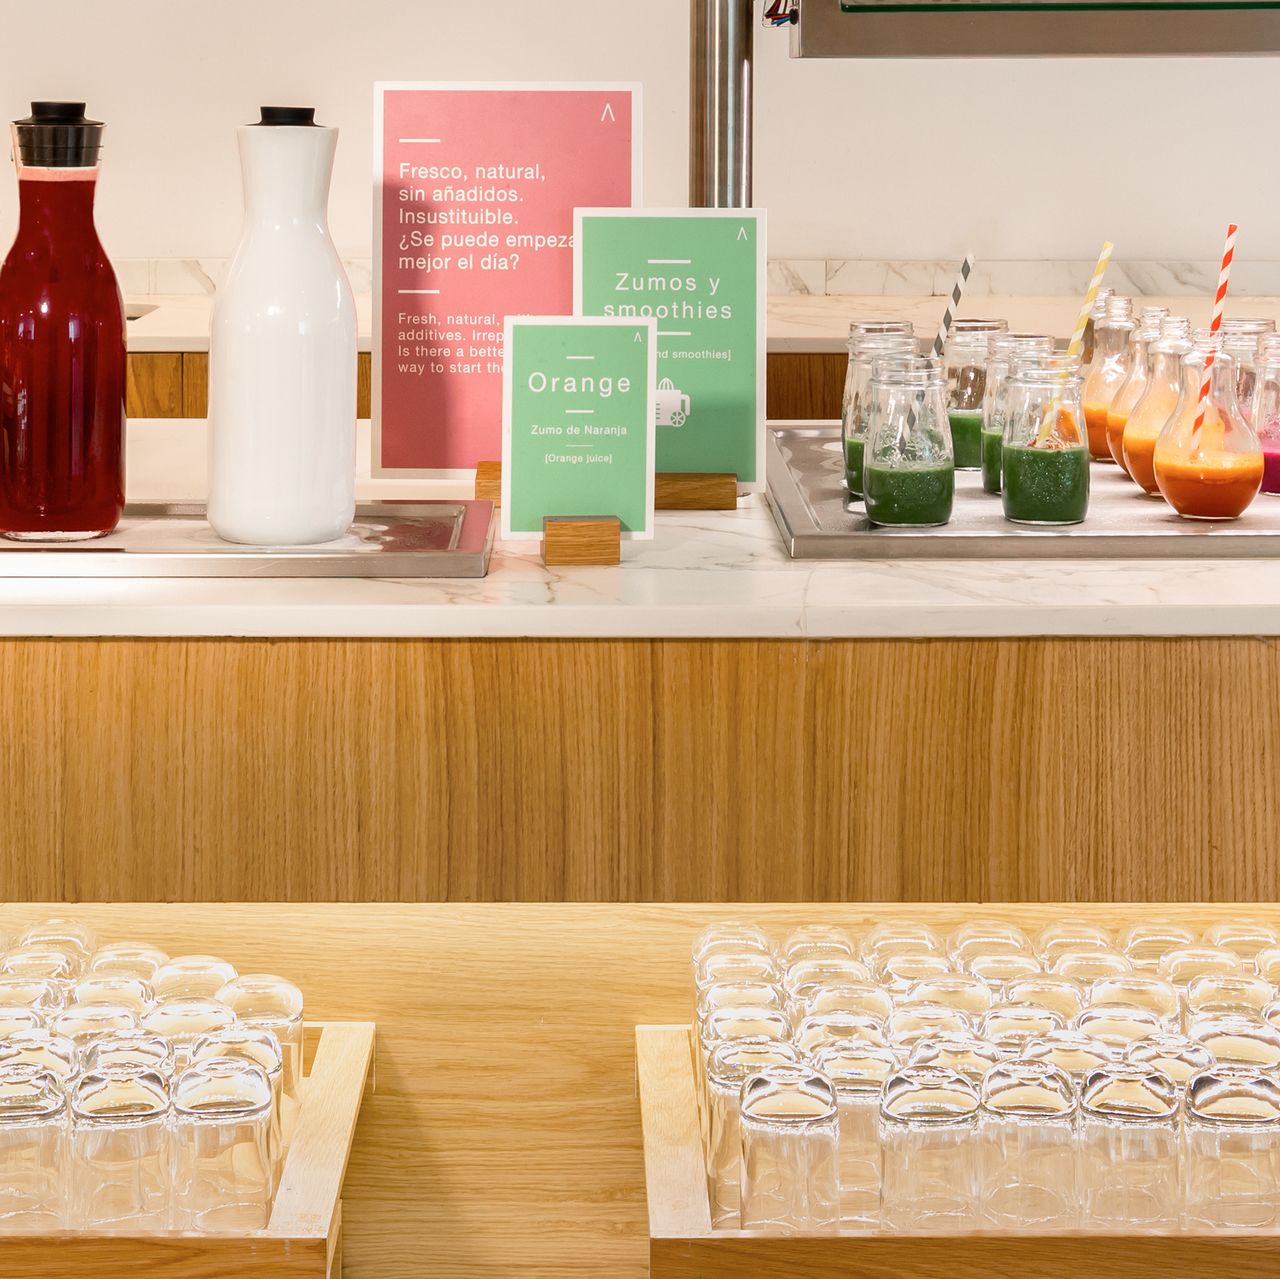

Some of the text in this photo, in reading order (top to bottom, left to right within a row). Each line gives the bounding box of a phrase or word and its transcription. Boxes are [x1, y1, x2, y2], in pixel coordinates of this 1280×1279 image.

[399, 162, 545, 181] Fresco, natural,
[399, 186, 523, 202] sin añadidos.
[399, 209, 518, 224] Insustituible.
[399, 231, 574, 250] ¿Se puede empeza
[399, 253, 519, 273] mejor el día?
[615, 272, 720, 295] Zumos y
[604, 301, 732, 319] smoothies
[398, 313, 500, 326] Fresh, natural,
[398, 330, 466, 340] additives.
[399, 345, 504, 357] Is there a bette
[657, 350, 731, 360] nd smoothies]
[398, 364, 424, 375] way
[431, 363, 444, 372] to
[450, 362, 481, 373] start
[528, 372, 630, 397] Orange
[531, 425, 627, 436] Zumo de Naranja
[545, 454, 612, 464] [Orange juice]
